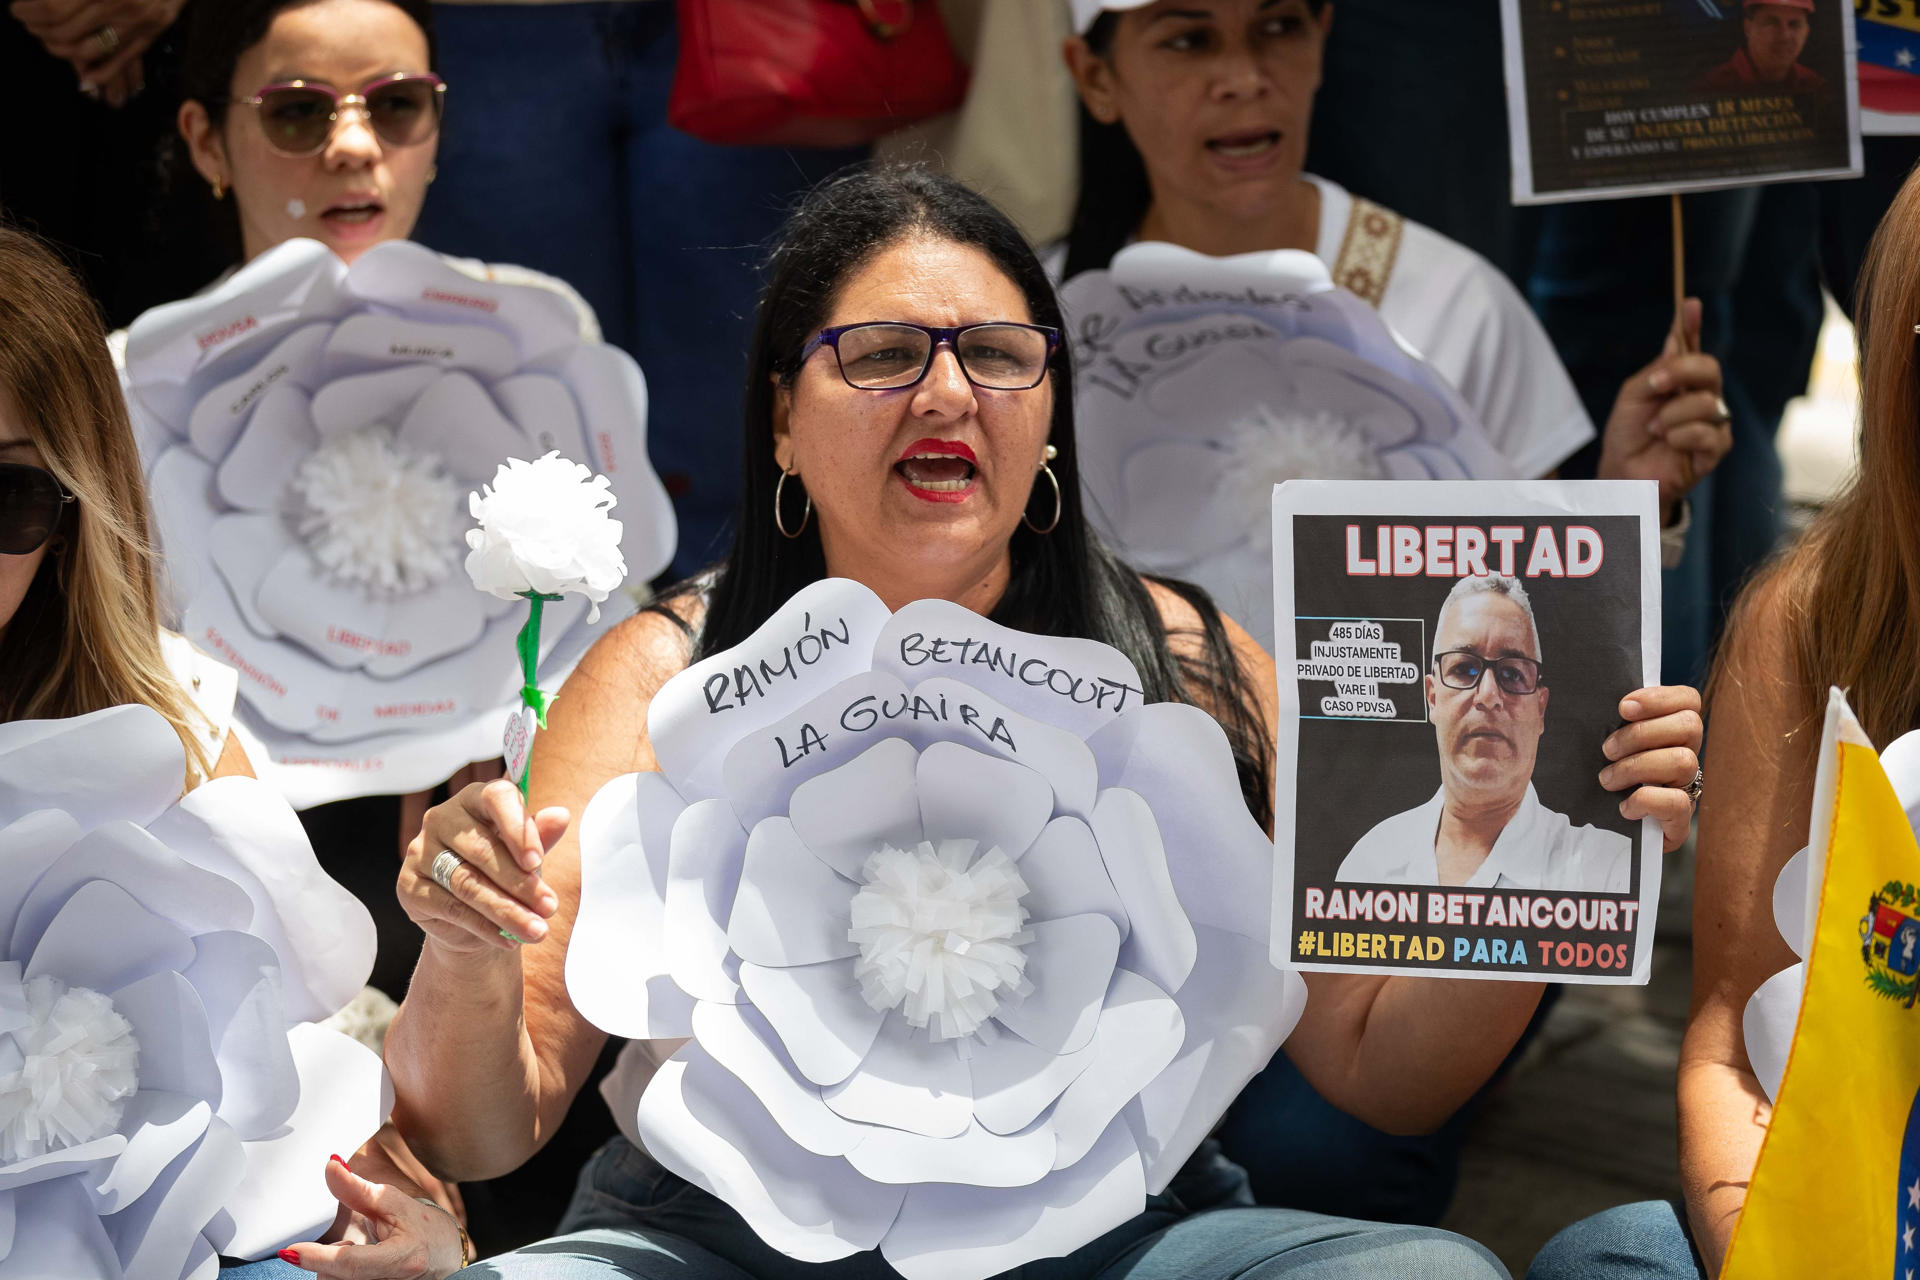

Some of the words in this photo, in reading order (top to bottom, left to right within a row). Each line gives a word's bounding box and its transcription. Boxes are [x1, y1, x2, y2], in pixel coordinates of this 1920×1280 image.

[1345, 524, 1604, 578] LIBERTAD
[1332, 627, 1352, 639] 485
[1355, 625, 1381, 640] DÍAS
[702, 611, 851, 714] RAMÓN
[899, 631, 1145, 713] BETANCOURT
[1313, 645, 1398, 660] INJUSTAMENTE
[1297, 663, 1345, 677] PRIVADO
[1347, 665, 1362, 678] DE
[1364, 666, 1416, 679] LIBERTAD
[1338, 683, 1367, 695] YARE
[1369, 684, 1376, 696] II
[1324, 700, 1354, 712] CASO
[1356, 701, 1394, 713] PDVSA
[774, 722, 830, 769] LA
[1304, 887, 1420, 924] RAMON
[1427, 892, 1640, 932] BETANCOURT
[1298, 930, 1446, 961] #LIBERTAD
[1453, 937, 1529, 966] PARA
[1537, 940, 1629, 969] TODOS
